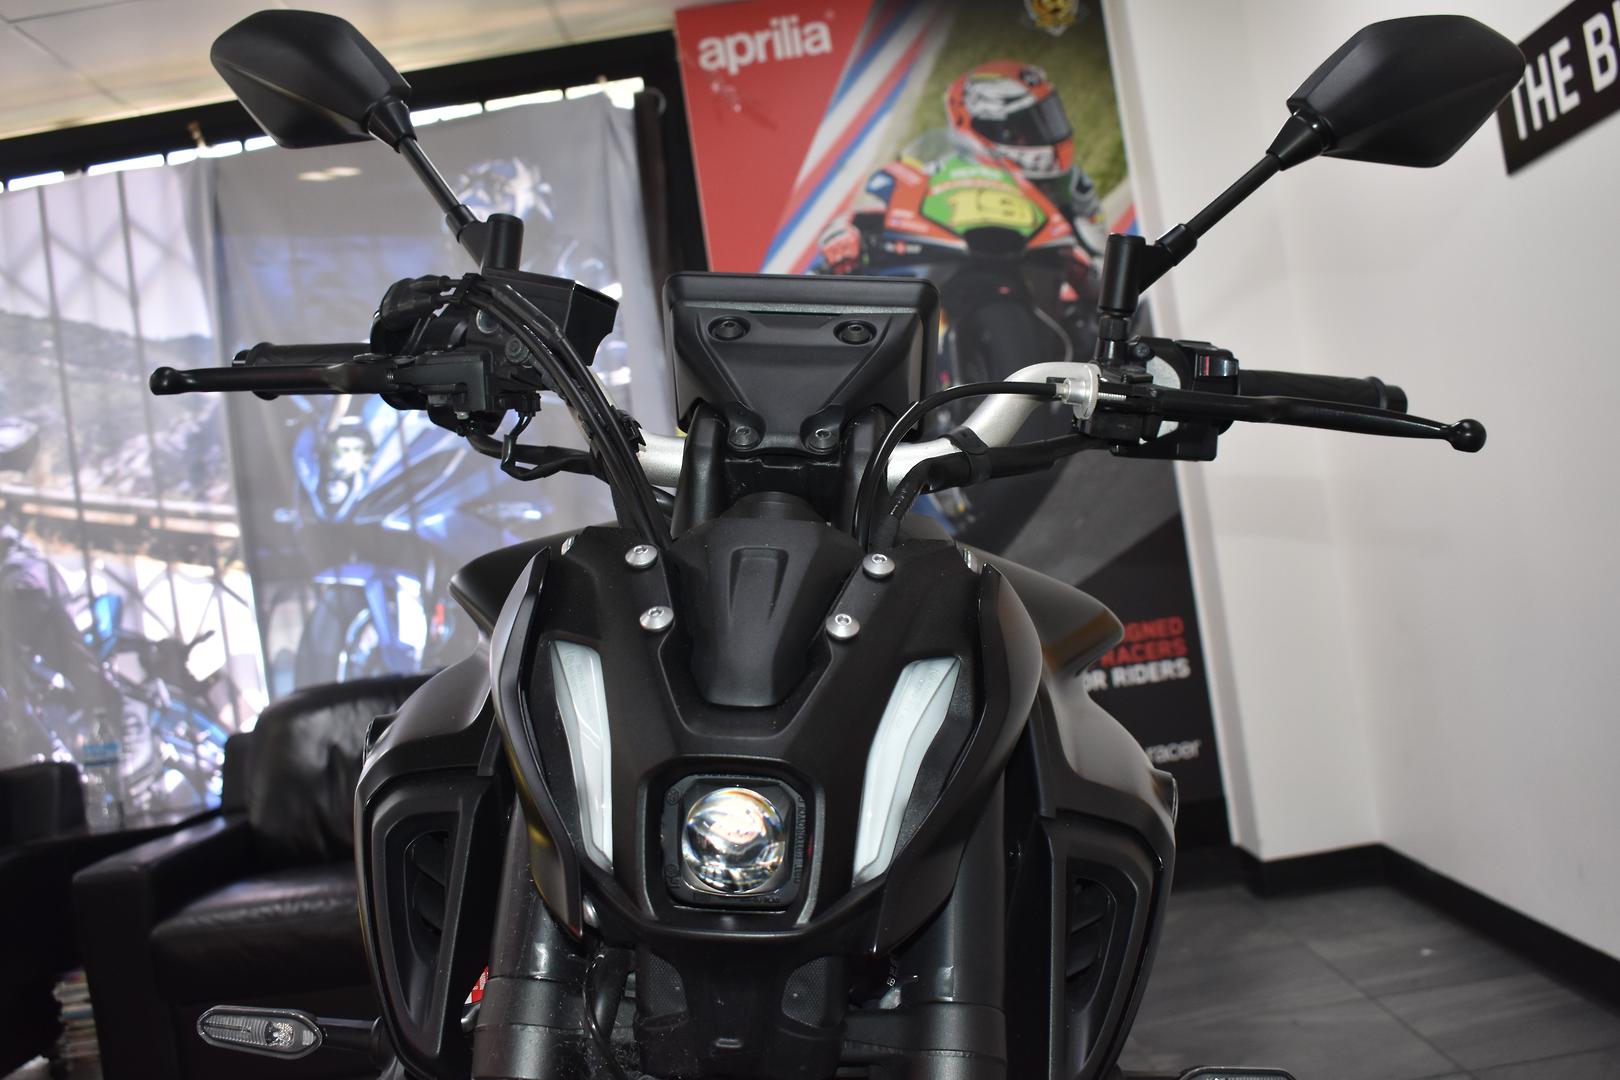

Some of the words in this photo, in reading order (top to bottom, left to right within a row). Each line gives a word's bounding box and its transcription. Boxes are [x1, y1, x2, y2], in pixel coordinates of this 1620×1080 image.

[698, 15, 832, 75] aprilia
[1083, 668, 1108, 692] OR
[1111, 657, 1191, 688] RIDERS
